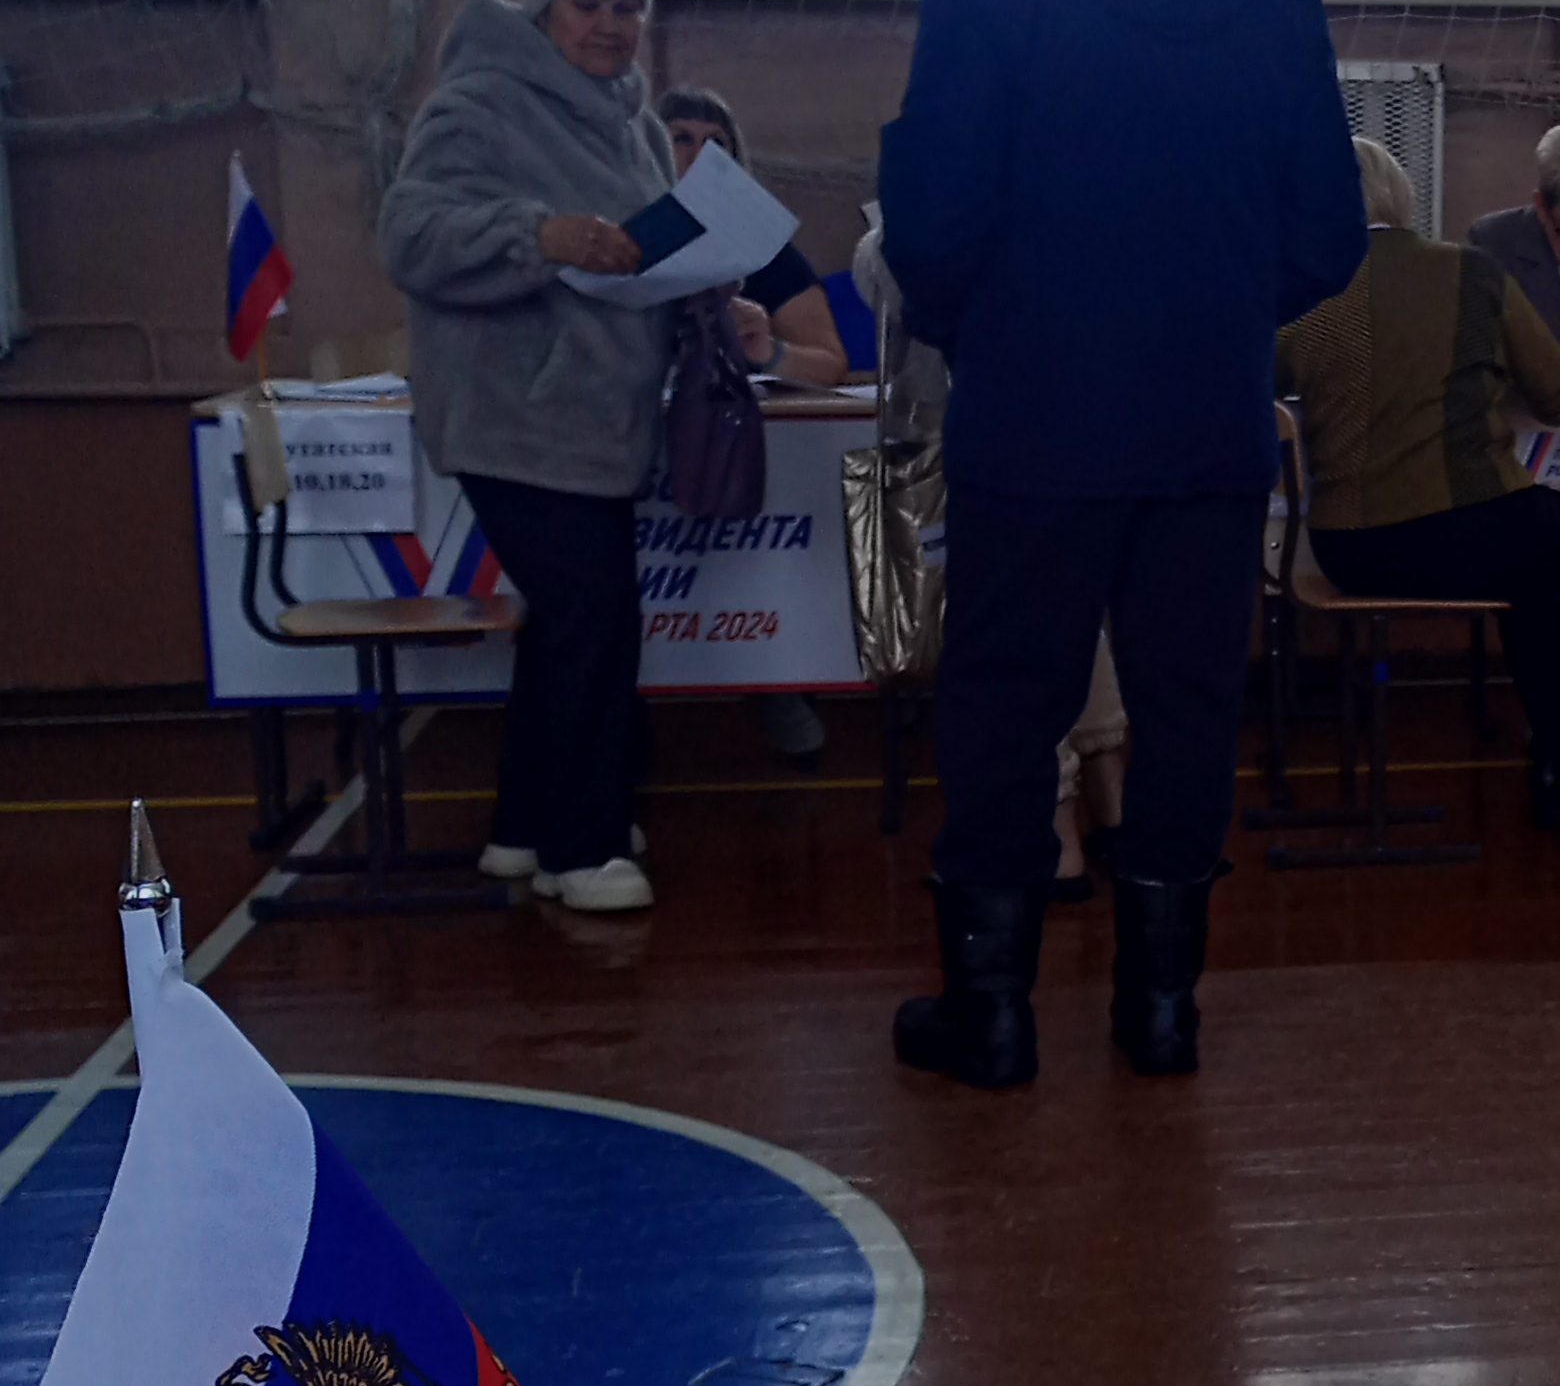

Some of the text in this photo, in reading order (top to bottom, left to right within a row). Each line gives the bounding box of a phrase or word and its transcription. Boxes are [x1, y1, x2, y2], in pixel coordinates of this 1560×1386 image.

[634, 515, 813, 556] ЗИДЕНТА
[644, 611, 780, 643] РТА 2024
